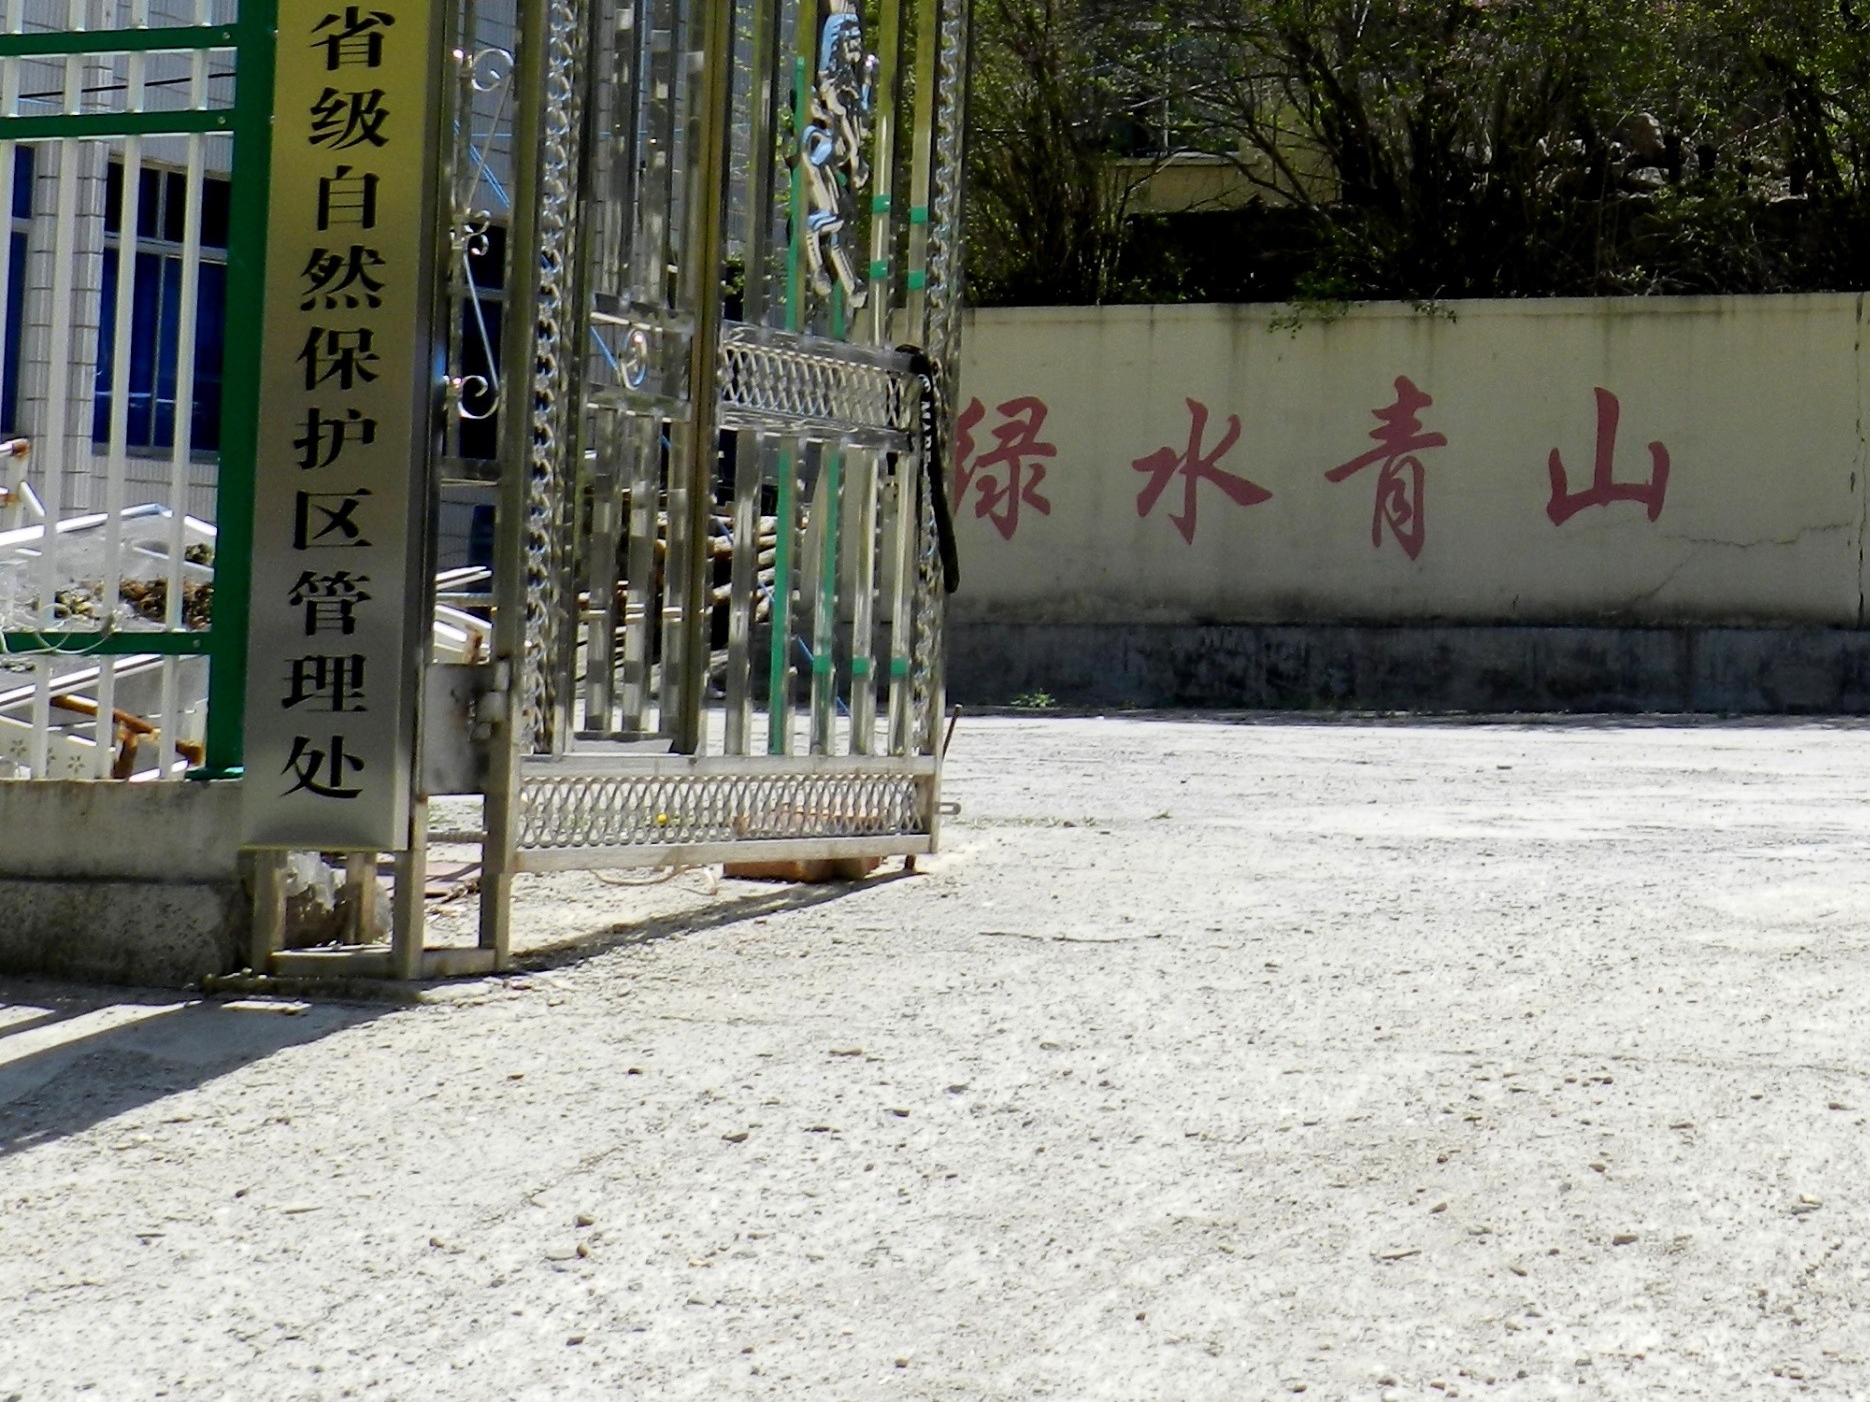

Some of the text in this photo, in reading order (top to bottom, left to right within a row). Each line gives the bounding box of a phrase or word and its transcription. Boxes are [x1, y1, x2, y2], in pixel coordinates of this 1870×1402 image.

[280, 4, 397, 799] 省级自然保护区管理处
[953, 374, 1672, 562] 绿水青山
